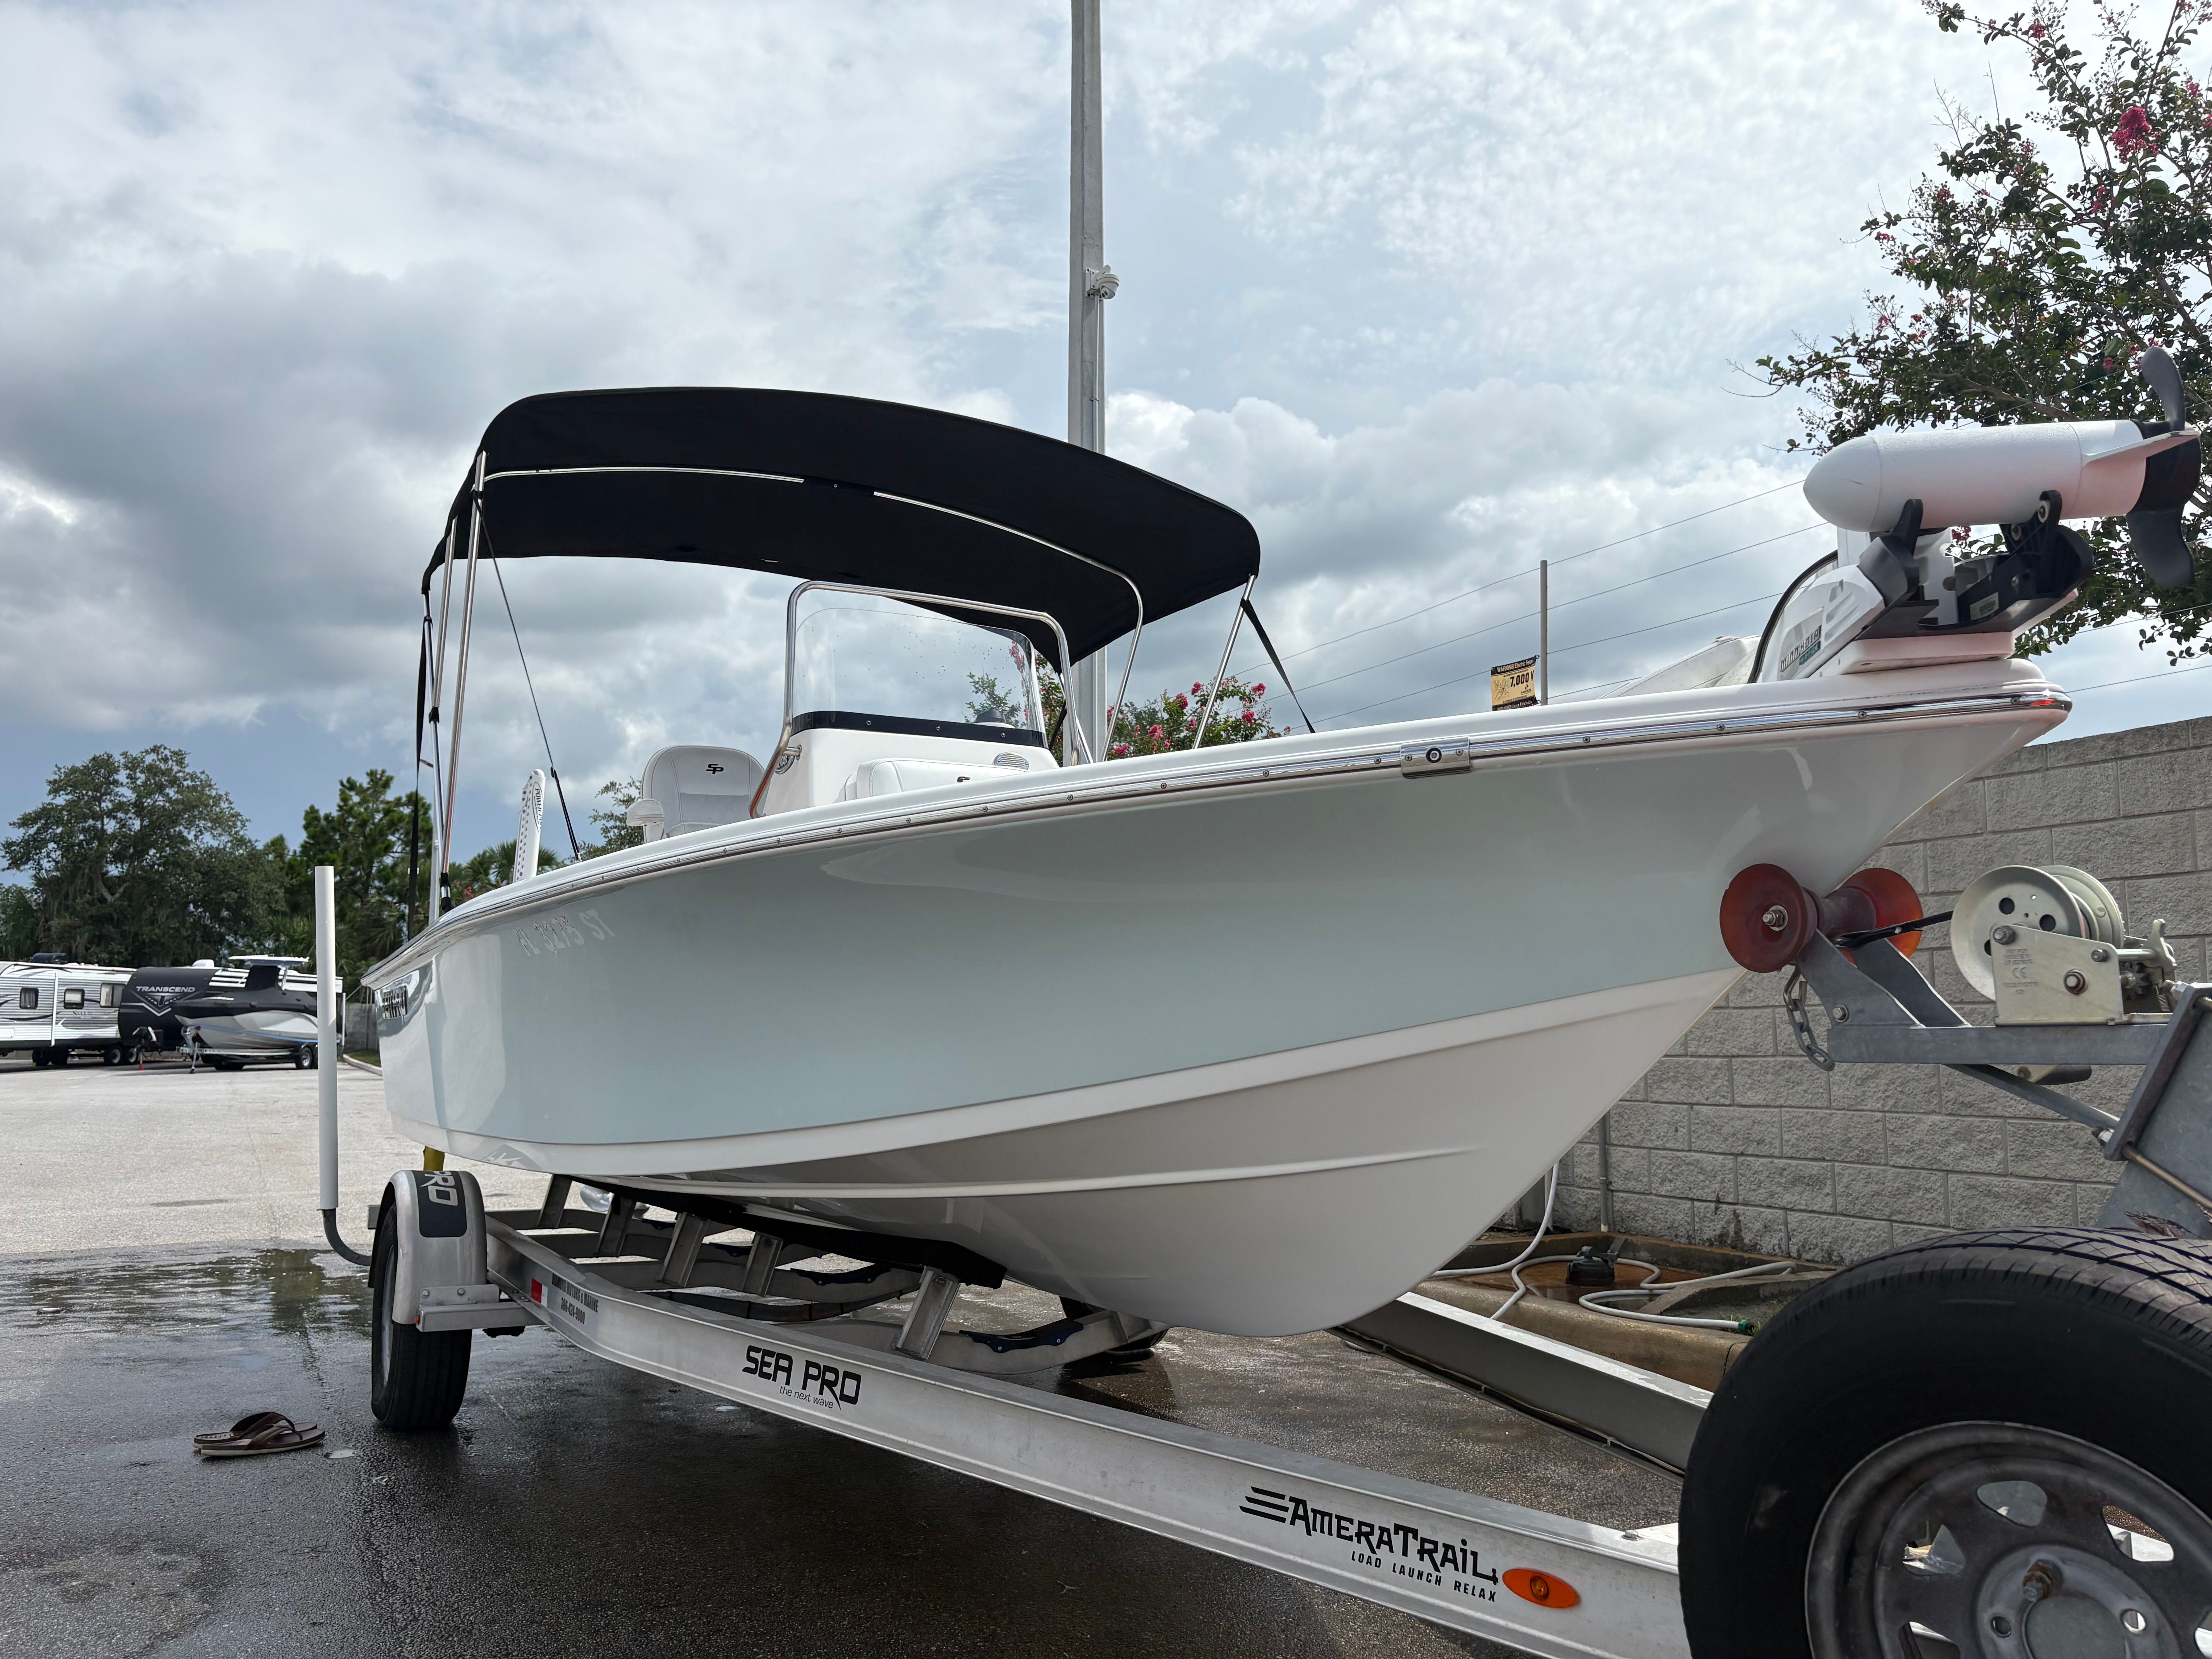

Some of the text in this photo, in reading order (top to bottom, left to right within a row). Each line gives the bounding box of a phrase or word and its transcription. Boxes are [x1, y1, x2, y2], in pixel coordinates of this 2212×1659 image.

[1510, 672, 1529, 687] 7,000
[1531, 670, 1534, 681] V
[579, 909, 615, 941] ST
[742, 1345, 862, 1410] SEA PRO
[780, 1386, 834, 1408] the next wave
[1351, 1551, 1496, 1602] LOAD LAUNCH RELAX
